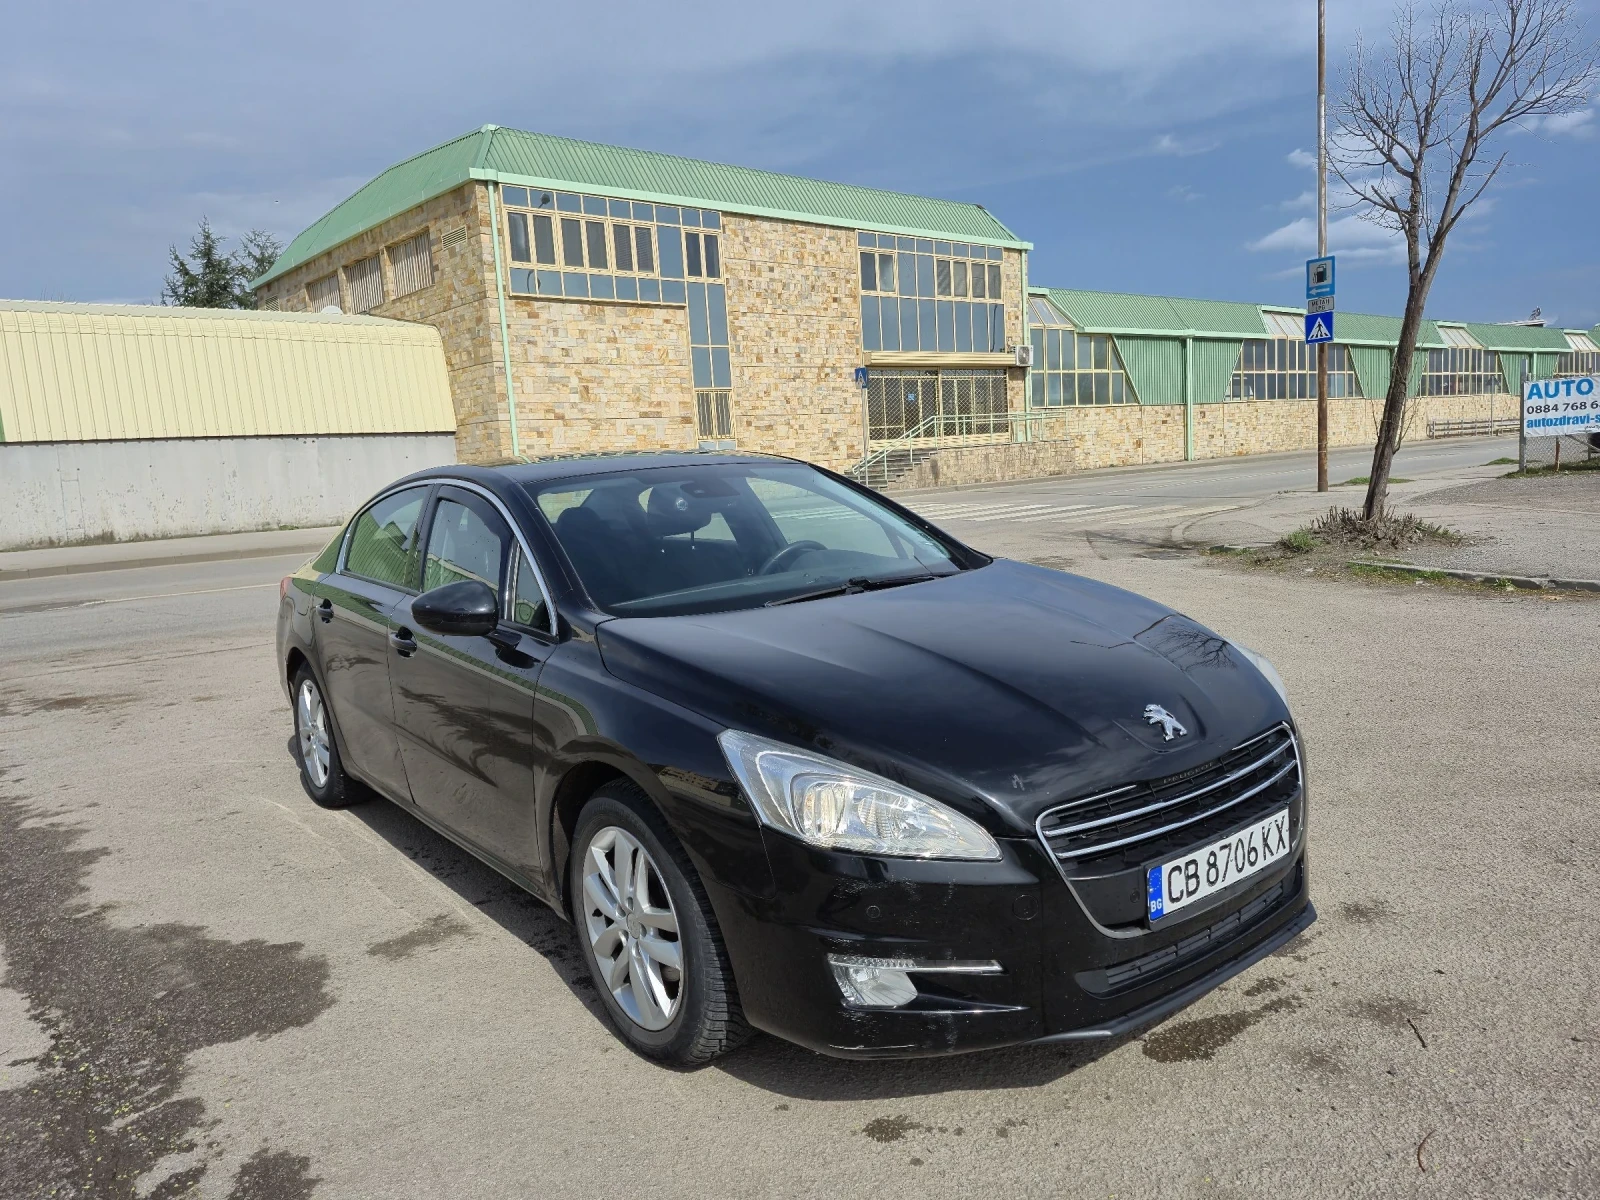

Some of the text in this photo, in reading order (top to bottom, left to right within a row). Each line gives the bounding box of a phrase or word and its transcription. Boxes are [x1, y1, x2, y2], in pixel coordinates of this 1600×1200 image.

[1527, 378, 1594, 400] AUTO
[1526, 400, 1600, 415] 0884 768 6
[1167, 815, 1287, 904] CB 8706 KX
[1150, 898, 1163, 912] BG
